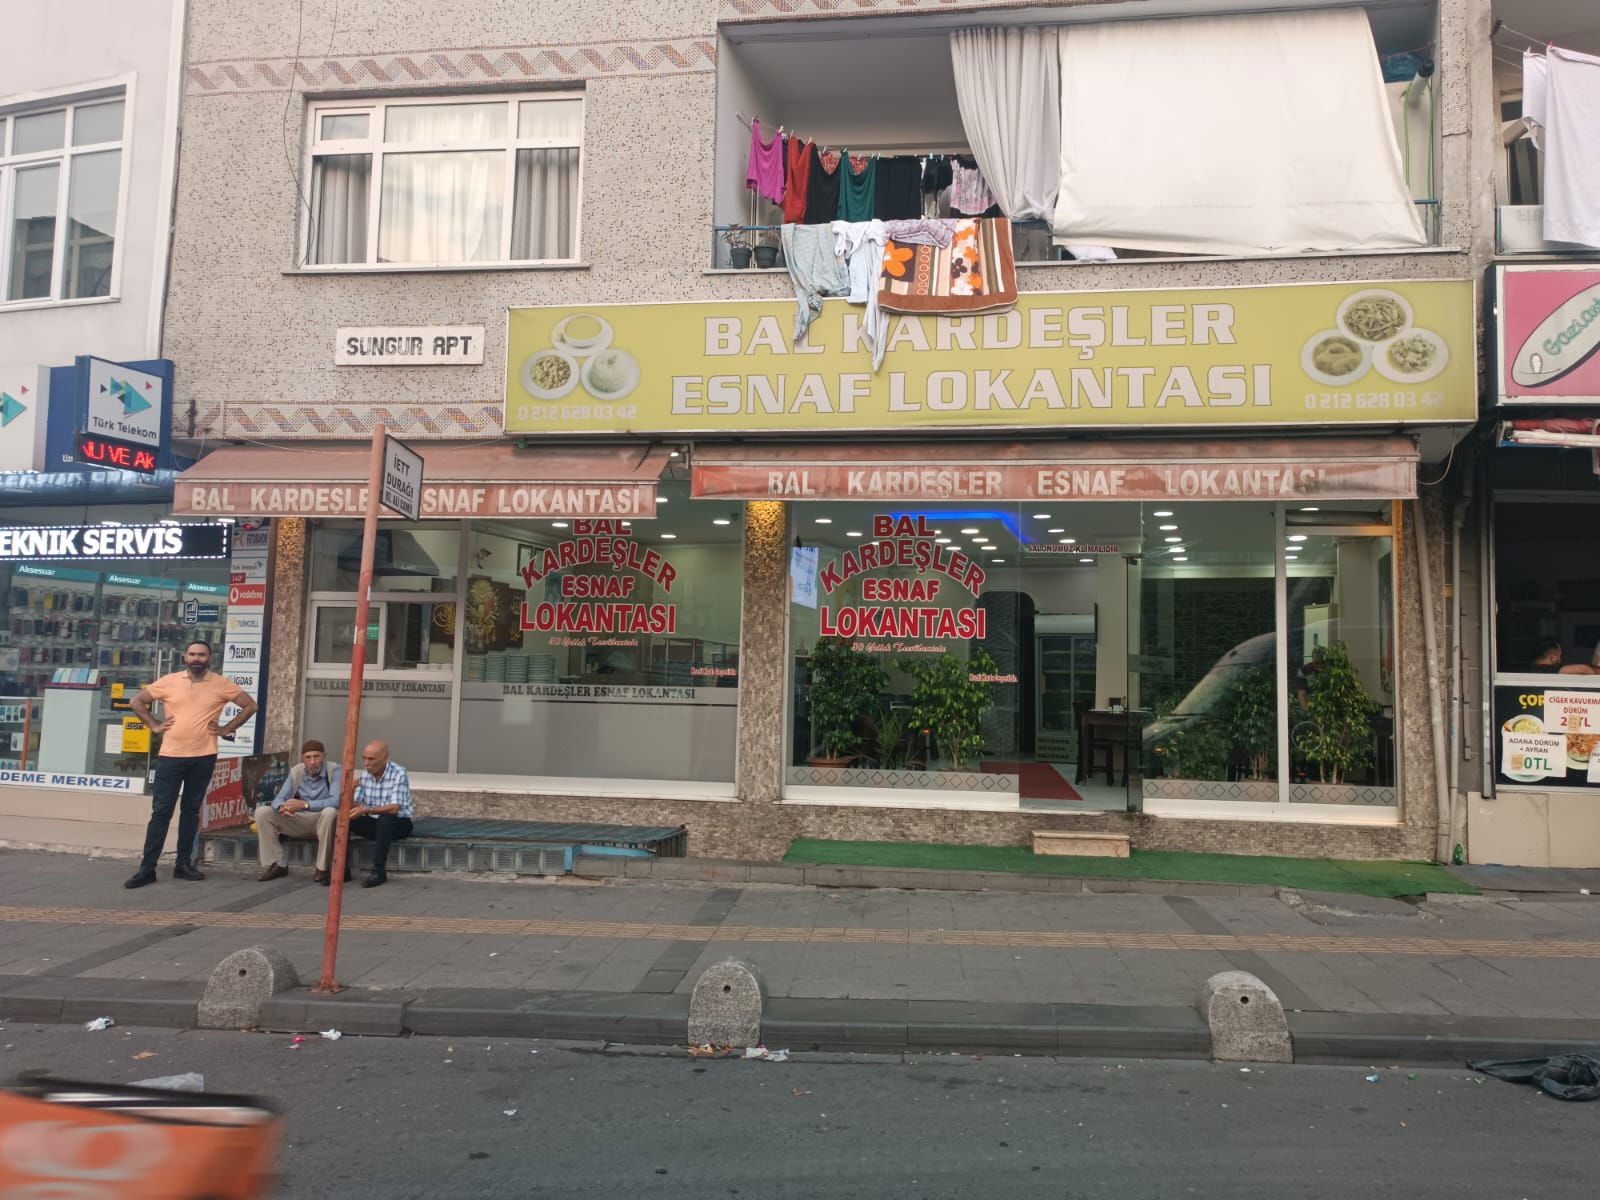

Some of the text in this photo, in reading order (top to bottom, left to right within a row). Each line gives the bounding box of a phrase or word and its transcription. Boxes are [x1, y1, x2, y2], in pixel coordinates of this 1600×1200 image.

[704, 303, 1236, 360] BAL KARDEŞLER
[346, 336, 472, 356] SUNGUR APT
[670, 364, 1273, 415] ESNAF LOKANTASI
[93, 416, 157, 439] Türk Telekom
[394, 453, 410, 476] İETT
[386, 472, 414, 499] DURAĞI
[768, 471, 815, 496] BAL
[1037, 470, 1125, 496] ESNAF
[191, 487, 640, 514] BAL KARDEŞLE SNAF LOKANTASI
[572, 519, 632, 536] BAL
[873, 515, 936, 537] BAL
[1027, 544, 1073, 553] SALONUMUZ
[18, 565, 56, 577] Aksesuar
[520, 537, 677, 592] KARDEŞLER
[819, 539, 986, 599] KARDEŞLER
[108, 574, 141, 585] Aksesuar
[562, 575, 635, 598] ESNAF
[862, 578, 941, 601] ESNAF
[519, 602, 677, 635] LOKANTASI
[819, 606, 986, 640] LOKANTASI
[526, 685, 591, 699] KARDEŞLER
[51, 774, 131, 789] MERKEZİ
